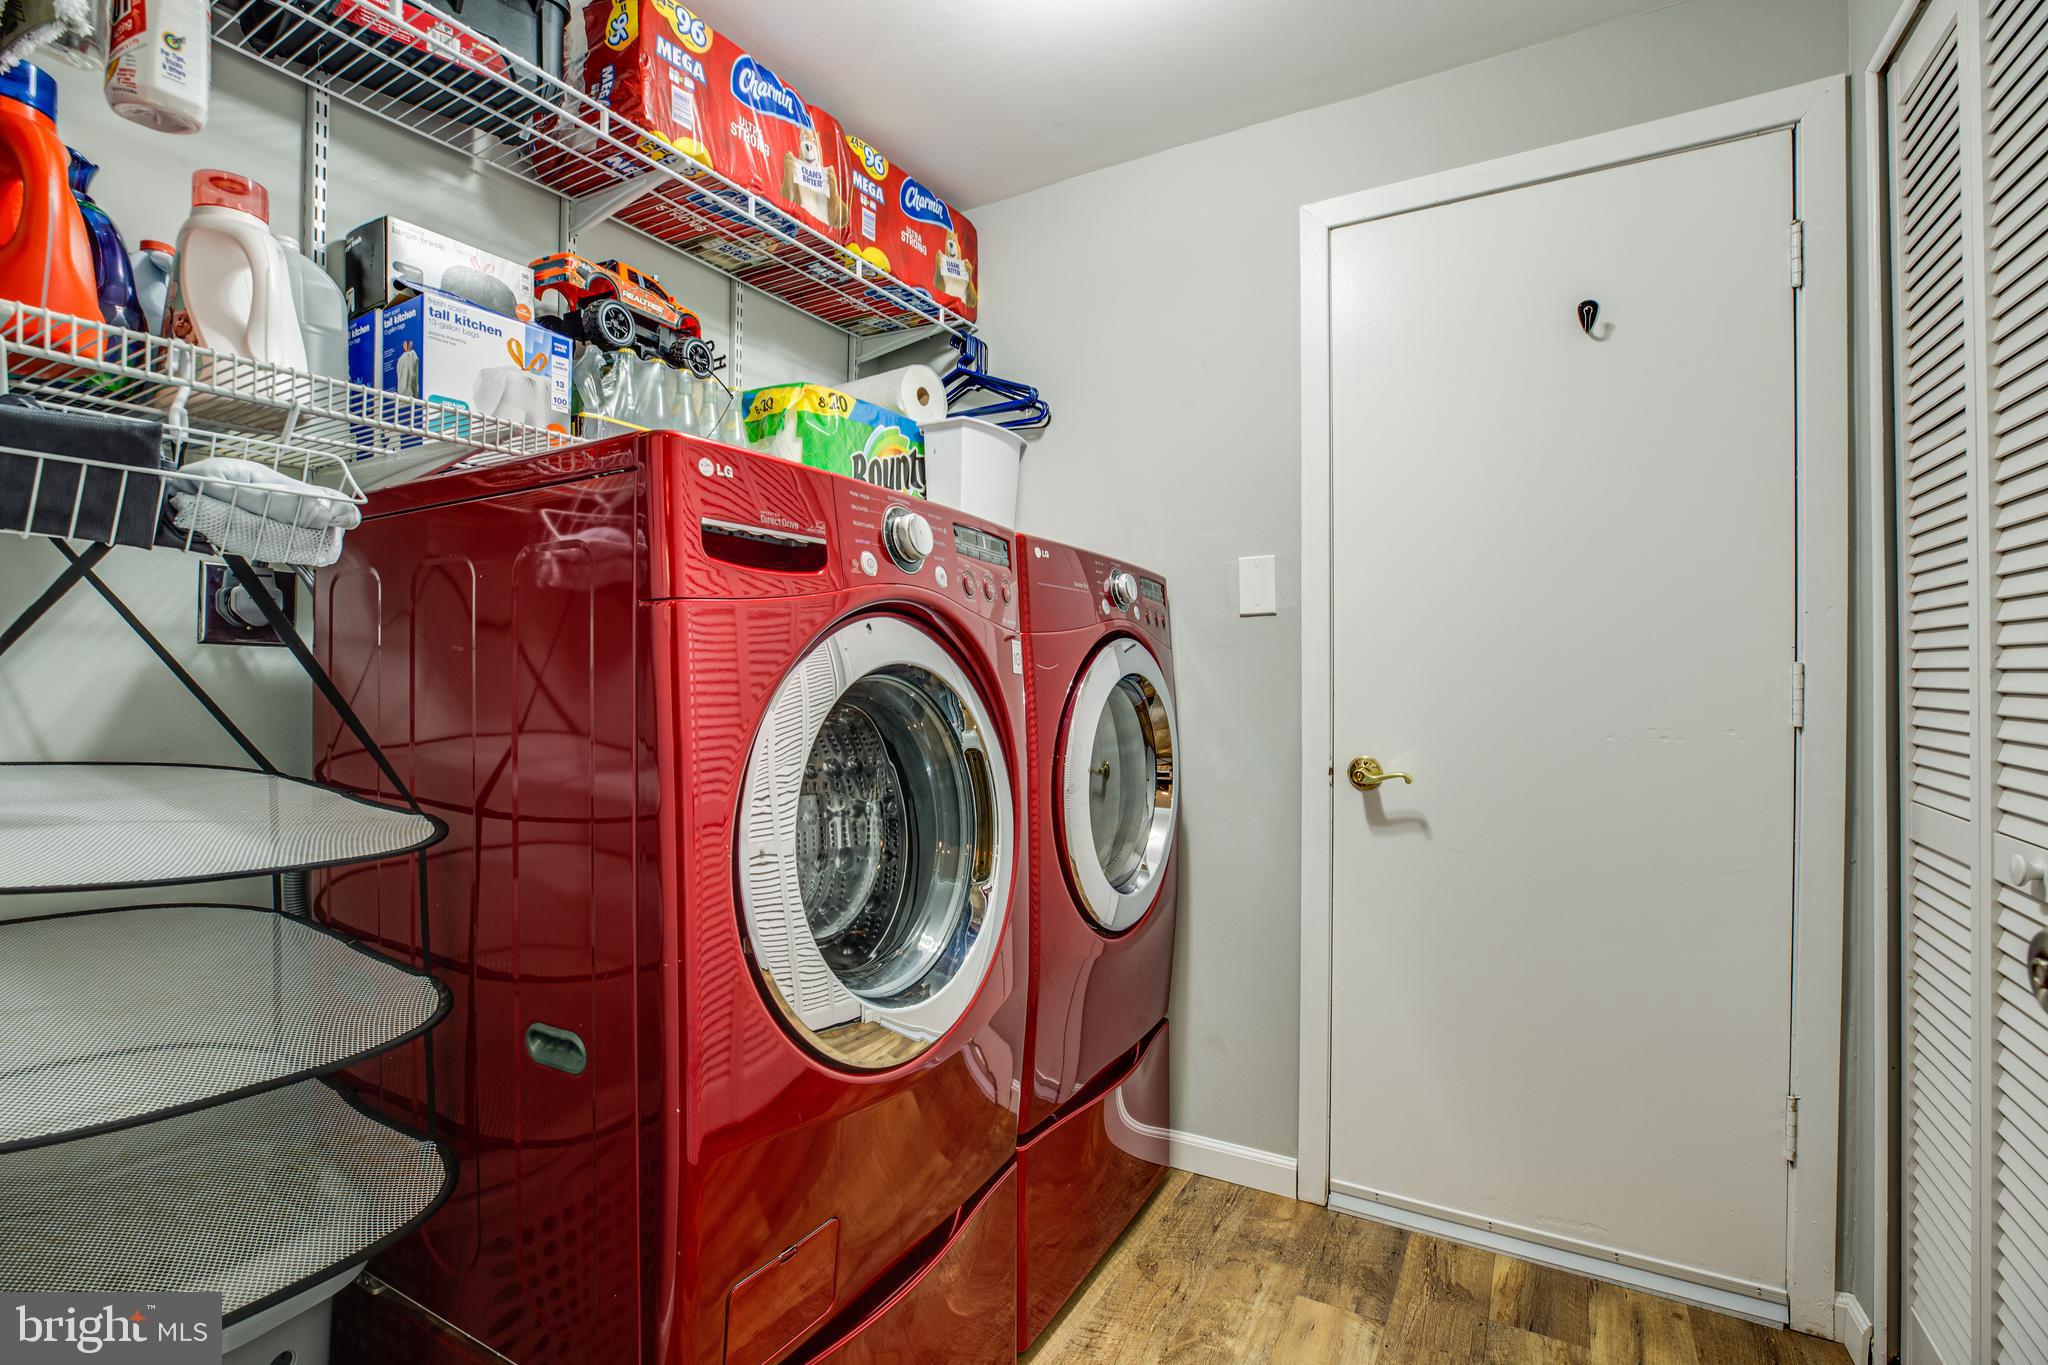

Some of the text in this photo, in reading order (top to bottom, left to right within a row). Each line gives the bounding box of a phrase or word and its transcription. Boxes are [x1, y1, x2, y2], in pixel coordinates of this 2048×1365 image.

[675, 5, 707, 48] 96
[656, 34, 707, 86] MEGA
[739, 67, 794, 114] Charmin
[730, 121, 770, 157] STRONG
[864, 144, 885, 176] 96
[852, 170, 885, 205] MEGA
[905, 186, 944, 220] Charmin
[901, 230, 928, 256] STRONG
[428, 306, 503, 337] tall kitchen
[462, 327, 480, 339] bags
[555, 379, 565, 389] 13
[553, 396, 568, 406] 100
[716, 463, 734, 479] LG
[852, 449, 927, 501] Bounty
